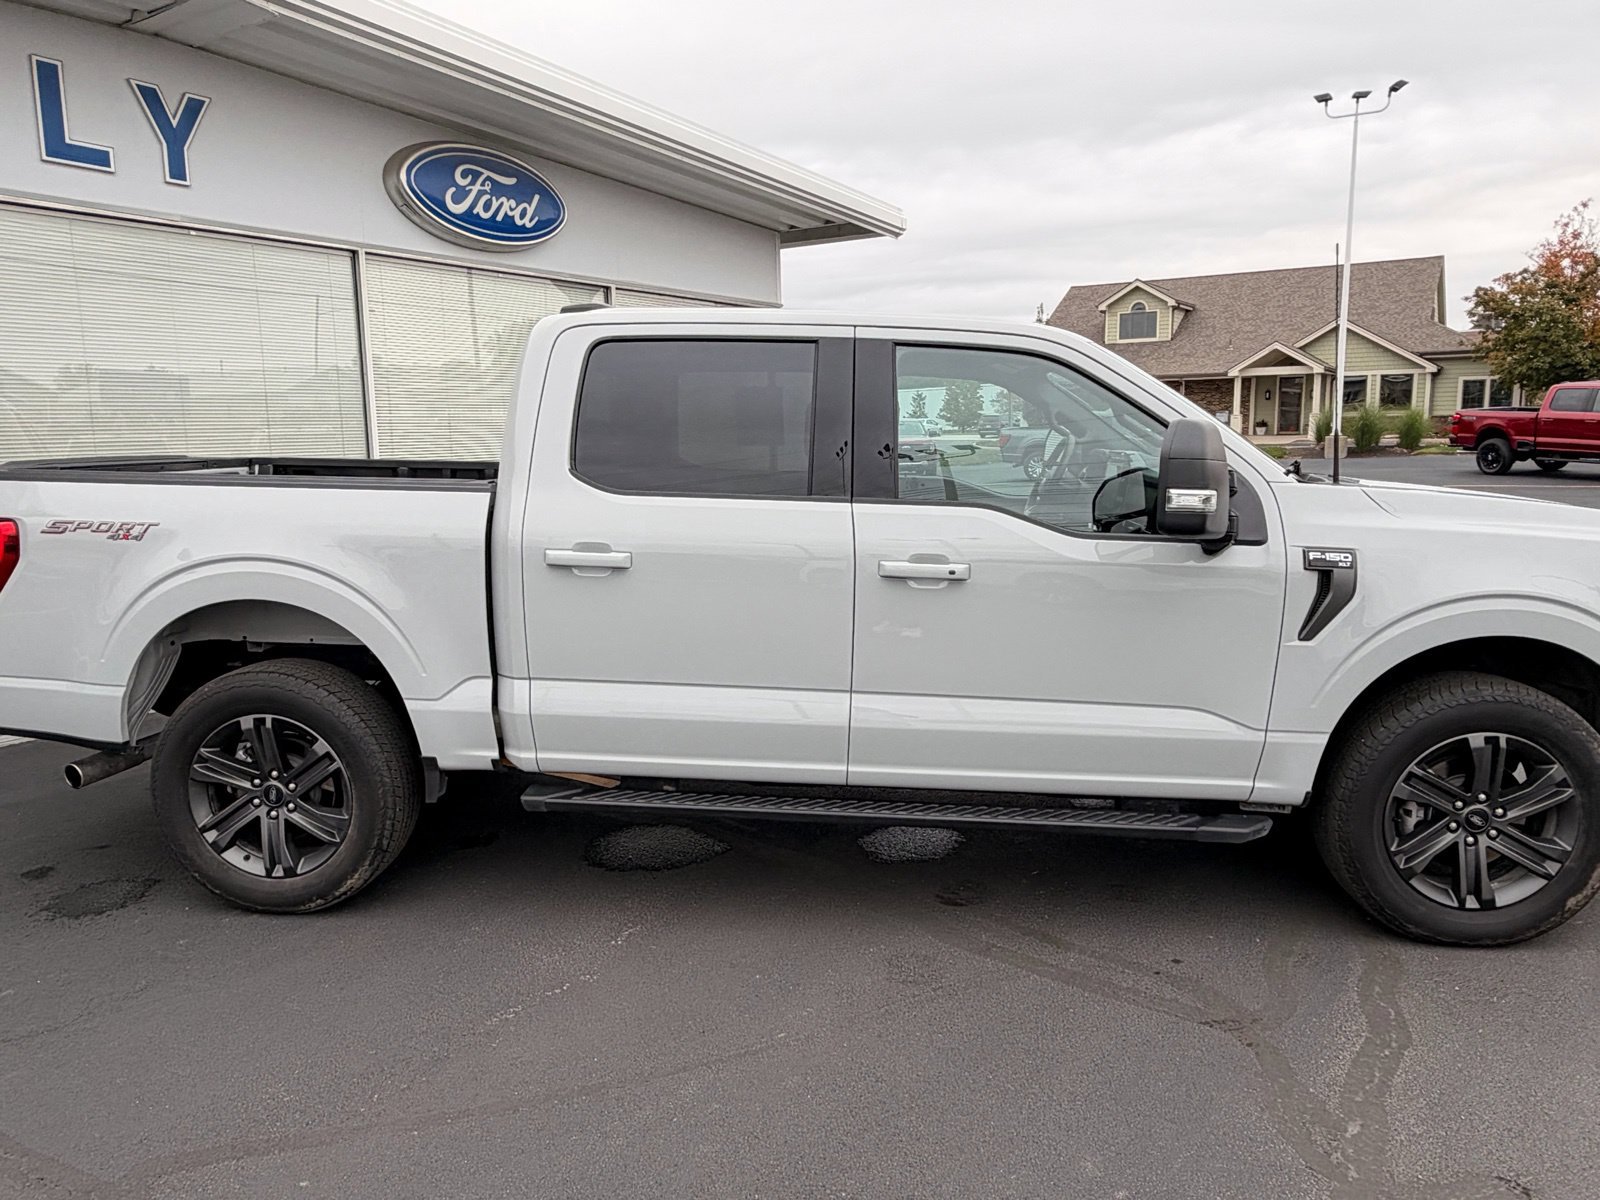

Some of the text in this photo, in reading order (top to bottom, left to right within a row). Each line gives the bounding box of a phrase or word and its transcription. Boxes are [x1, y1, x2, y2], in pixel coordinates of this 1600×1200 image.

[445, 164, 540, 228] Ford
[40, 519, 160, 535] SPORT
[1309, 552, 1352, 561] F-150
